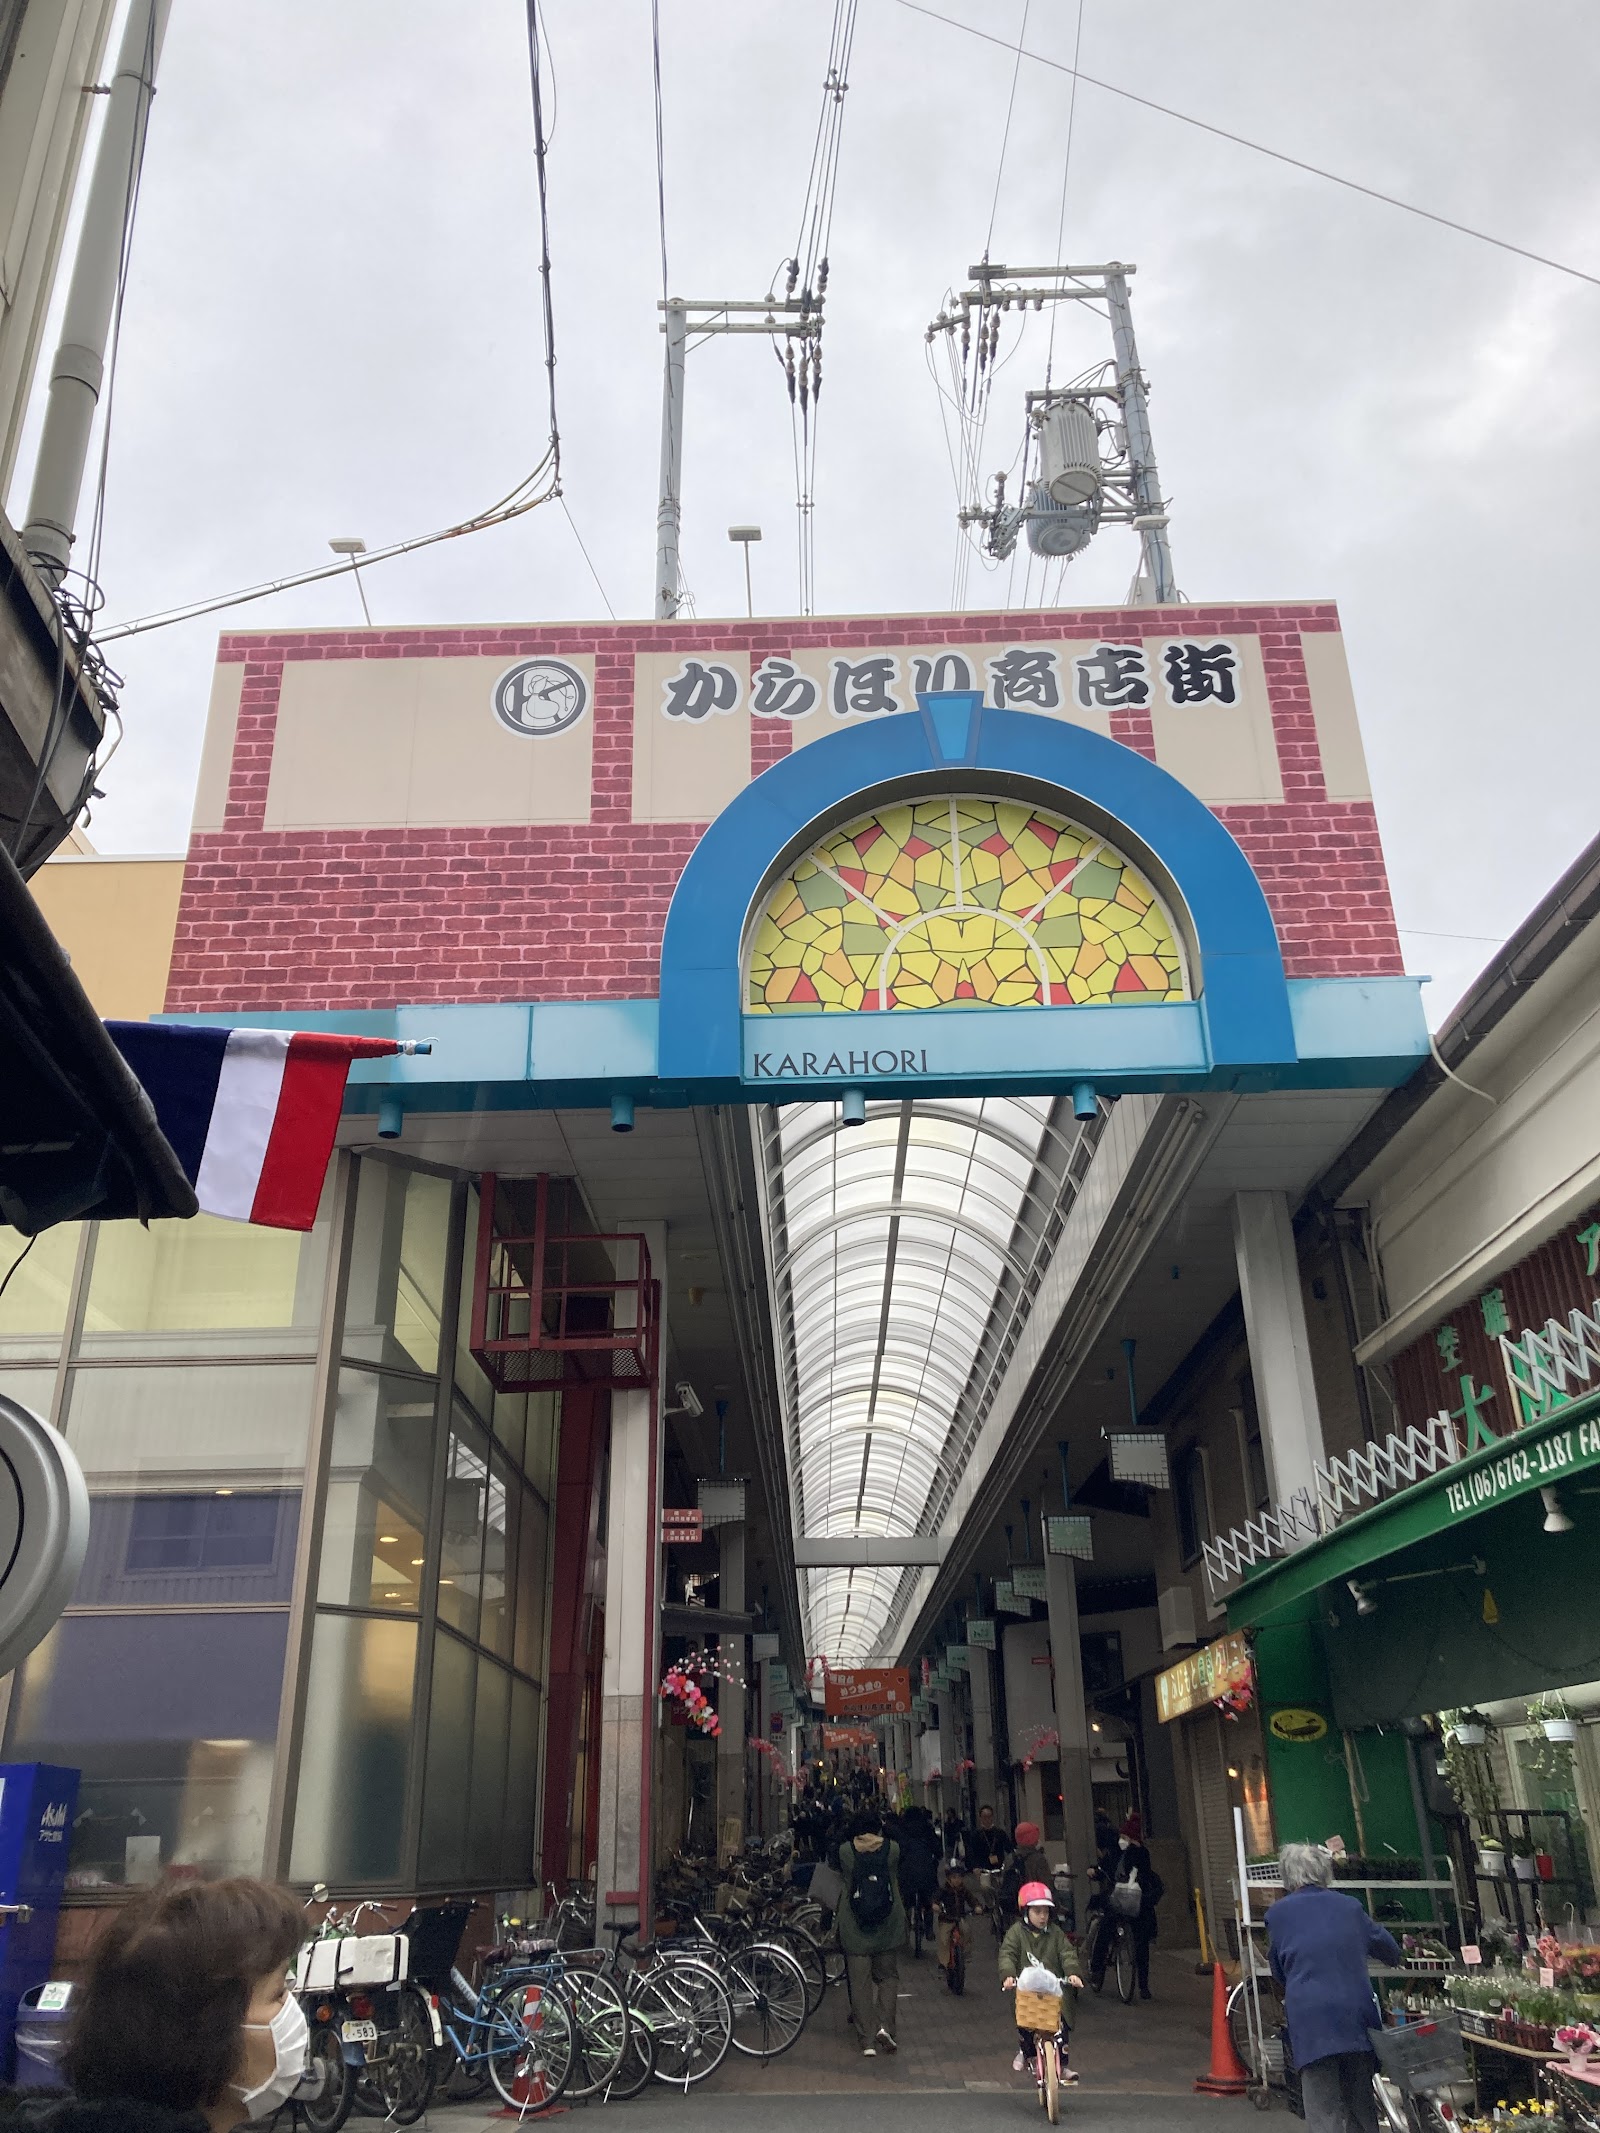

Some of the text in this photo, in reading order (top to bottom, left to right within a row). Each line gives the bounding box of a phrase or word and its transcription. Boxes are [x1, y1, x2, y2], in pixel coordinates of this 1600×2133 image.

[668, 643, 1237, 719] からほり商店街
[753, 1050, 928, 1077] KARAHORI
[1579, 1416, 1600, 1456] FA
